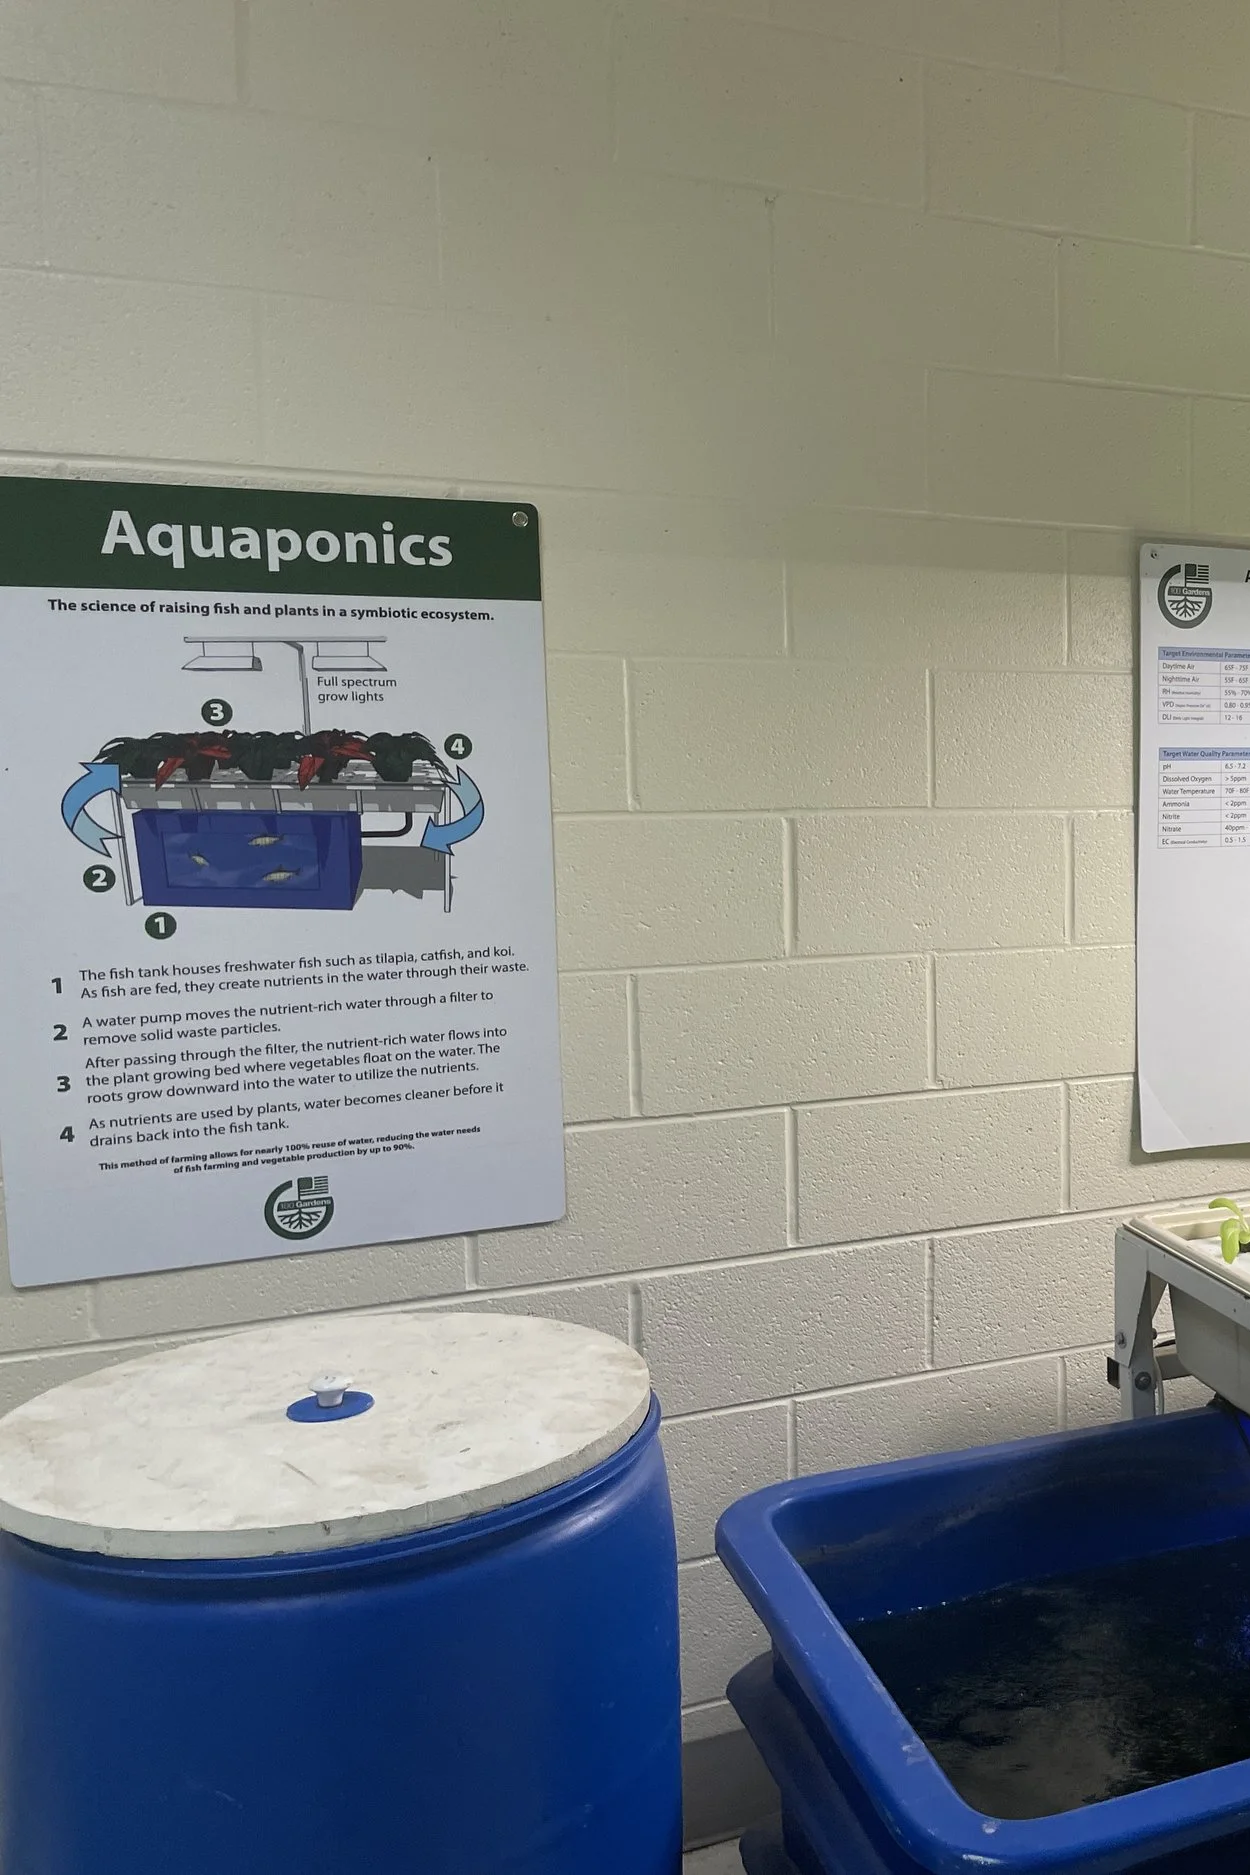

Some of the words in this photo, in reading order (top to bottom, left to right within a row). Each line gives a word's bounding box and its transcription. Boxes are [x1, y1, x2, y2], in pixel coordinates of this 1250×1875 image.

[100, 510, 454, 572] Aquaponics
[48, 599, 77, 611] The
[81, 600, 137, 612] science
[140, 601, 156, 612] of
[159, 602, 210, 616] raising
[214, 603, 240, 614] fish
[244, 604, 272, 615] and
[275, 605, 319, 618] plants
[322, 606, 336, 617] in
[351, 607, 418, 620] symbiotic
[421, 611, 495, 622] ecosystem.
[1163, 650, 1181, 658] Target
[317, 676, 338, 687] Full
[341, 679, 397, 688] spectrum
[318, 694, 349, 704] grow
[352, 691, 384, 704] lights
[210, 704, 224, 721] 3
[451, 738, 466, 754] 4
[93, 871, 107, 886] 2
[155, 918, 167, 933] 1
[79, 970, 106, 981] The
[110, 968, 134, 979] fish
[138, 966, 169, 978] tank
[173, 965, 221, 976] houses
[225, 961, 294, 972] freshwater
[299, 957, 322, 968] fish
[326, 955, 355, 967] such
[359, 957, 372, 965] as
[376, 953, 417, 965] tilapia,
[421, 949, 464, 961] catfish,
[468, 947, 490, 958] and
[494, 946, 514, 957] koi.
[51, 977, 62, 994] 1
[82, 1017, 93, 1028] A
[96, 1016, 137, 1027] water
[140, 1014, 182, 1026] pump
[186, 1010, 231, 1020] moves
[234, 1006, 256, 1017] the
[260, 1001, 342, 1015] nutrient-rich
[346, 1000, 382, 1010] water
[385, 994, 436, 1007] through
[450, 992, 478, 1002] filter
[481, 992, 494, 1000] to
[53, 1024, 68, 1041] 2
[84, 1034, 137, 1045] remove
[141, 1028, 173, 1041] solid
[177, 1027, 217, 1038] waste
[221, 1022, 281, 1038] particles.
[85, 1057, 120, 1068] After
[124, 1053, 177, 1068] passing
[180, 1048, 236, 1062] through
[239, 1046, 262, 1057] the
[265, 1044, 299, 1054] filter,
[301, 1041, 323, 1052] the
[327, 1035, 407, 1050] nutrient-rich
[410, 1033, 446, 1043] water
[448, 1030, 481, 1040] flows
[483, 1028, 507, 1038] into
[56, 1075, 71, 1092] 3
[89, 1118, 106, 1130] As
[110, 1114, 173, 1127] nutrients
[176, 1112, 198, 1122] are
[201, 1106, 234, 1119] used
[237, 1105, 254, 1118] by
[257, 1103, 301, 1116] plants,
[304, 1099, 341, 1109] water
[344, 1094, 402, 1106] becomes
[405, 1089, 451, 1100] cleaner
[453, 1084, 493, 1096] before
[496, 1082, 504, 1092] it
[60, 1126, 75, 1142] 4
[90, 1135, 133, 1147] drains
[136, 1129, 170, 1142] back
[173, 1128, 200, 1139] into
[203, 1125, 226, 1136] the
[229, 1122, 253, 1133] fish
[256, 1119, 289, 1131] tank.
[121, 1158, 158, 1168] method
[160, 1156, 169, 1164] of
[171, 1154, 208, 1164] farming
[255, 1146, 283, 1155] nearly
[286, 1144, 310, 1152] 100%
[376, 1134, 414, 1142] reducing
[456, 1126, 481, 1134] needs
